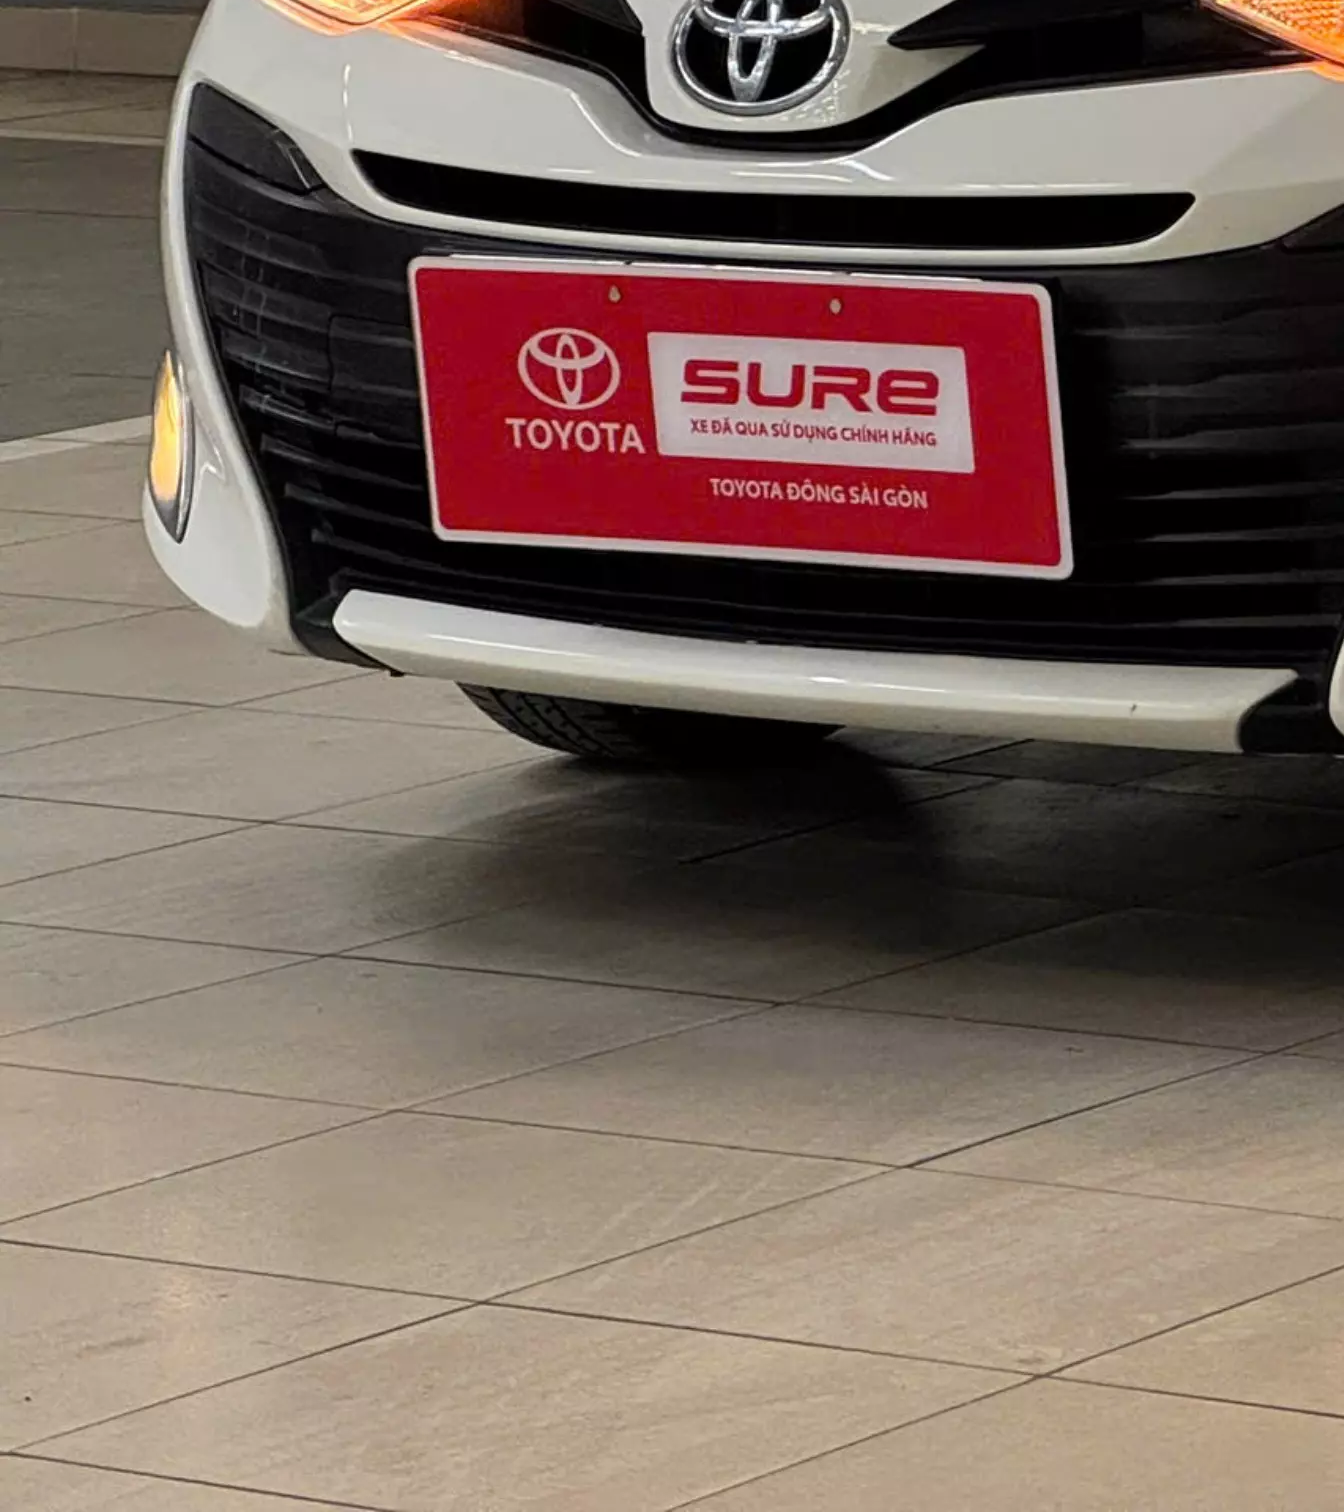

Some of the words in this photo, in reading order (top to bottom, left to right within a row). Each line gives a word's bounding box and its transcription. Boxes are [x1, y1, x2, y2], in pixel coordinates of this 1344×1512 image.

[504, 417, 647, 455] TOYOTA
[691, 418, 708, 434] XE
[711, 416, 733, 436] ĐÃ
[735, 421, 768, 438] QUA
[772, 419, 791, 439] SỬ
[794, 423, 837, 444] DỤNG
[840, 425, 889, 445] CHÍNH
[709, 478, 783, 501] TOYOTA
[786, 478, 846, 505] ĐÔNG
[848, 481, 879, 506] SÀI
[882, 484, 929, 509] GÒN
